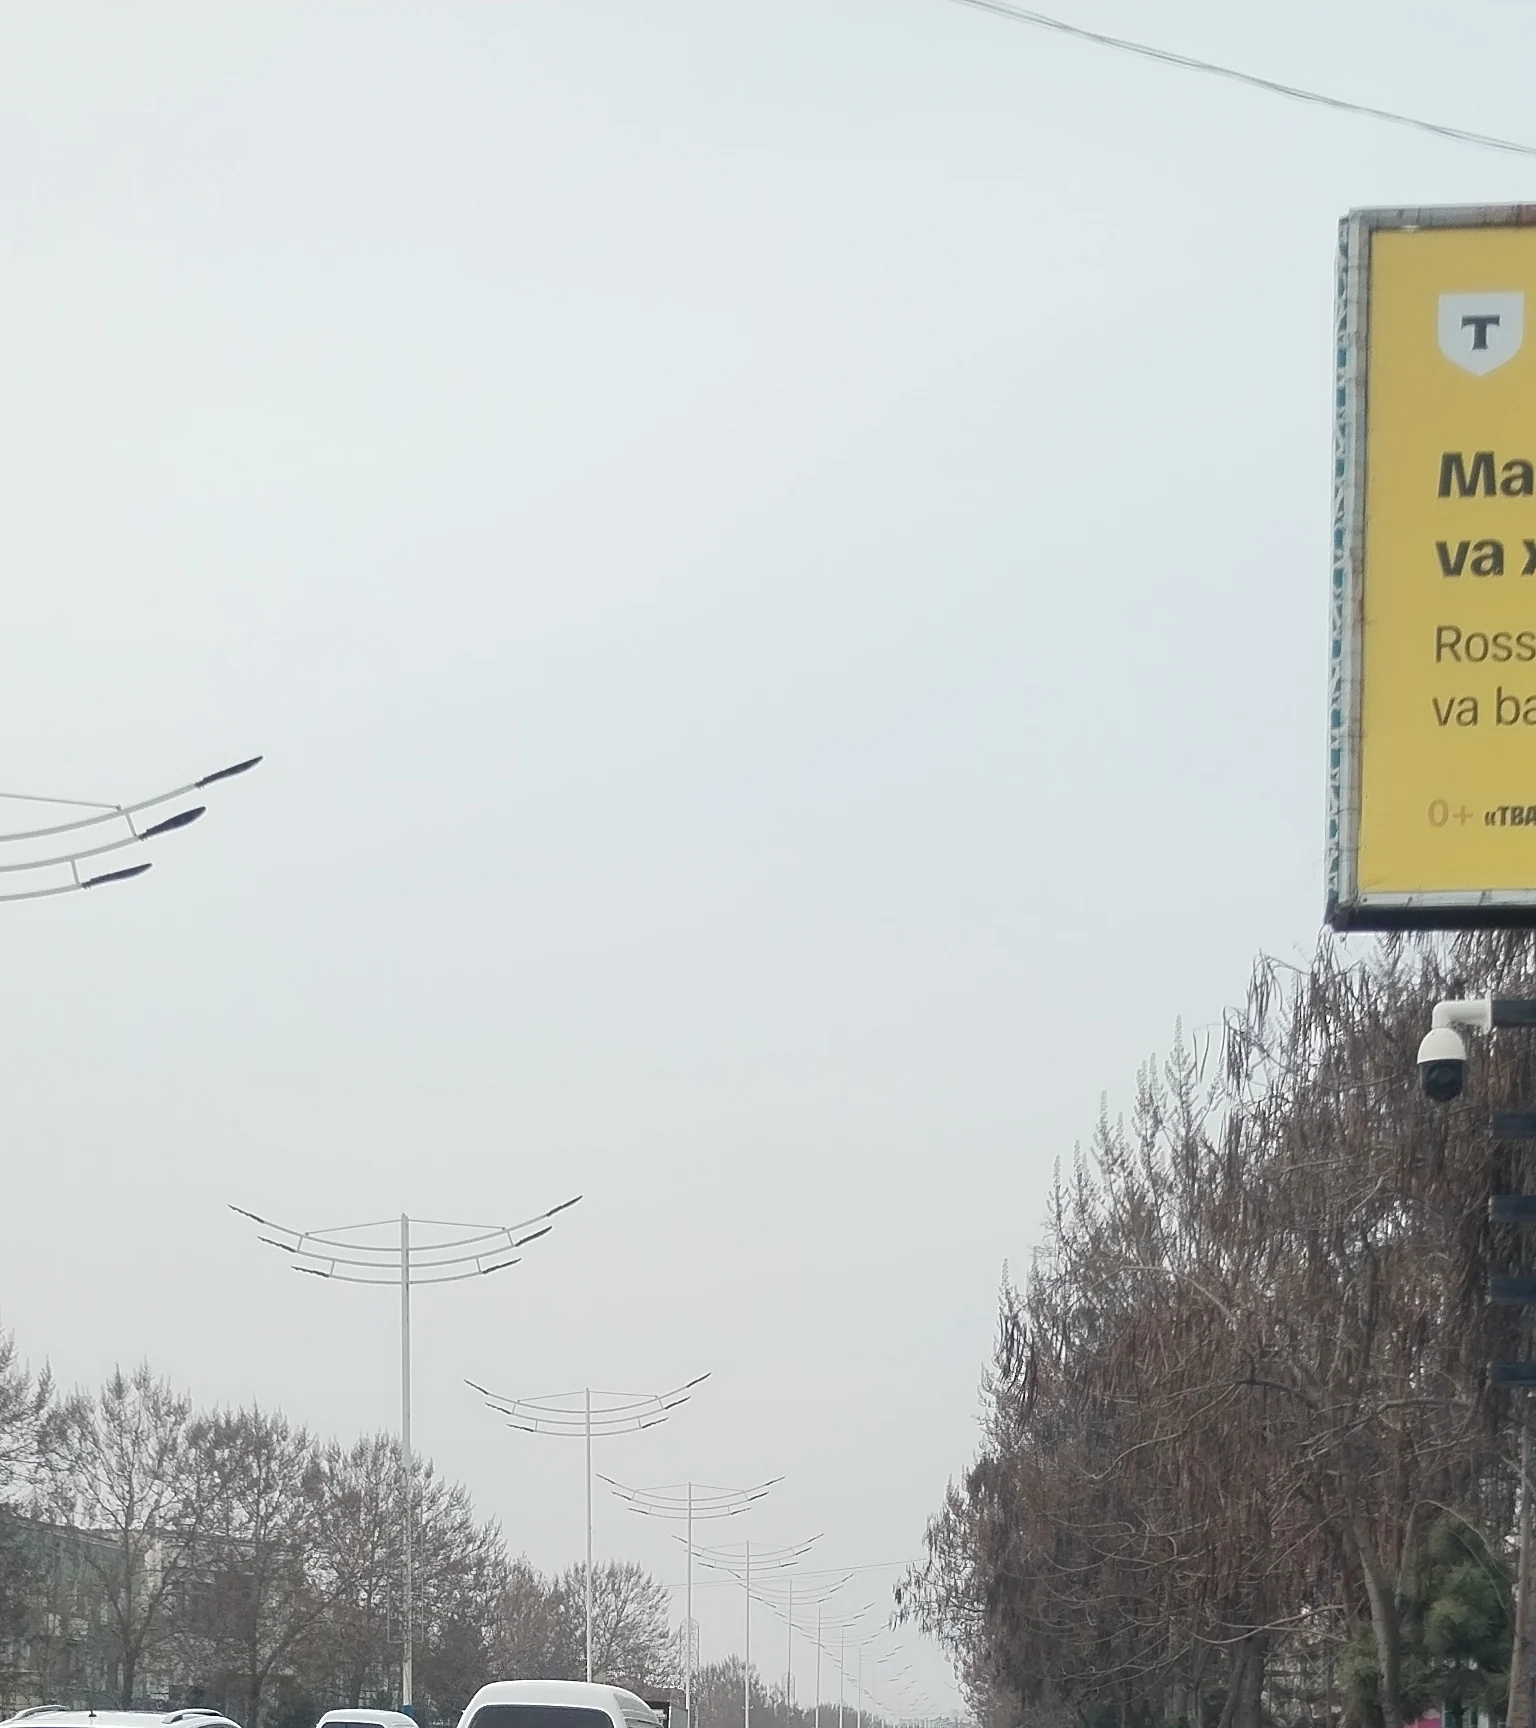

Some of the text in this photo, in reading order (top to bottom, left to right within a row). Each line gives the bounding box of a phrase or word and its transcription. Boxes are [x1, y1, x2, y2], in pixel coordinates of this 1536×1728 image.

[1460, 313, 1501, 351] T
[1433, 537, 1506, 580] va
[1430, 694, 1480, 728] va
